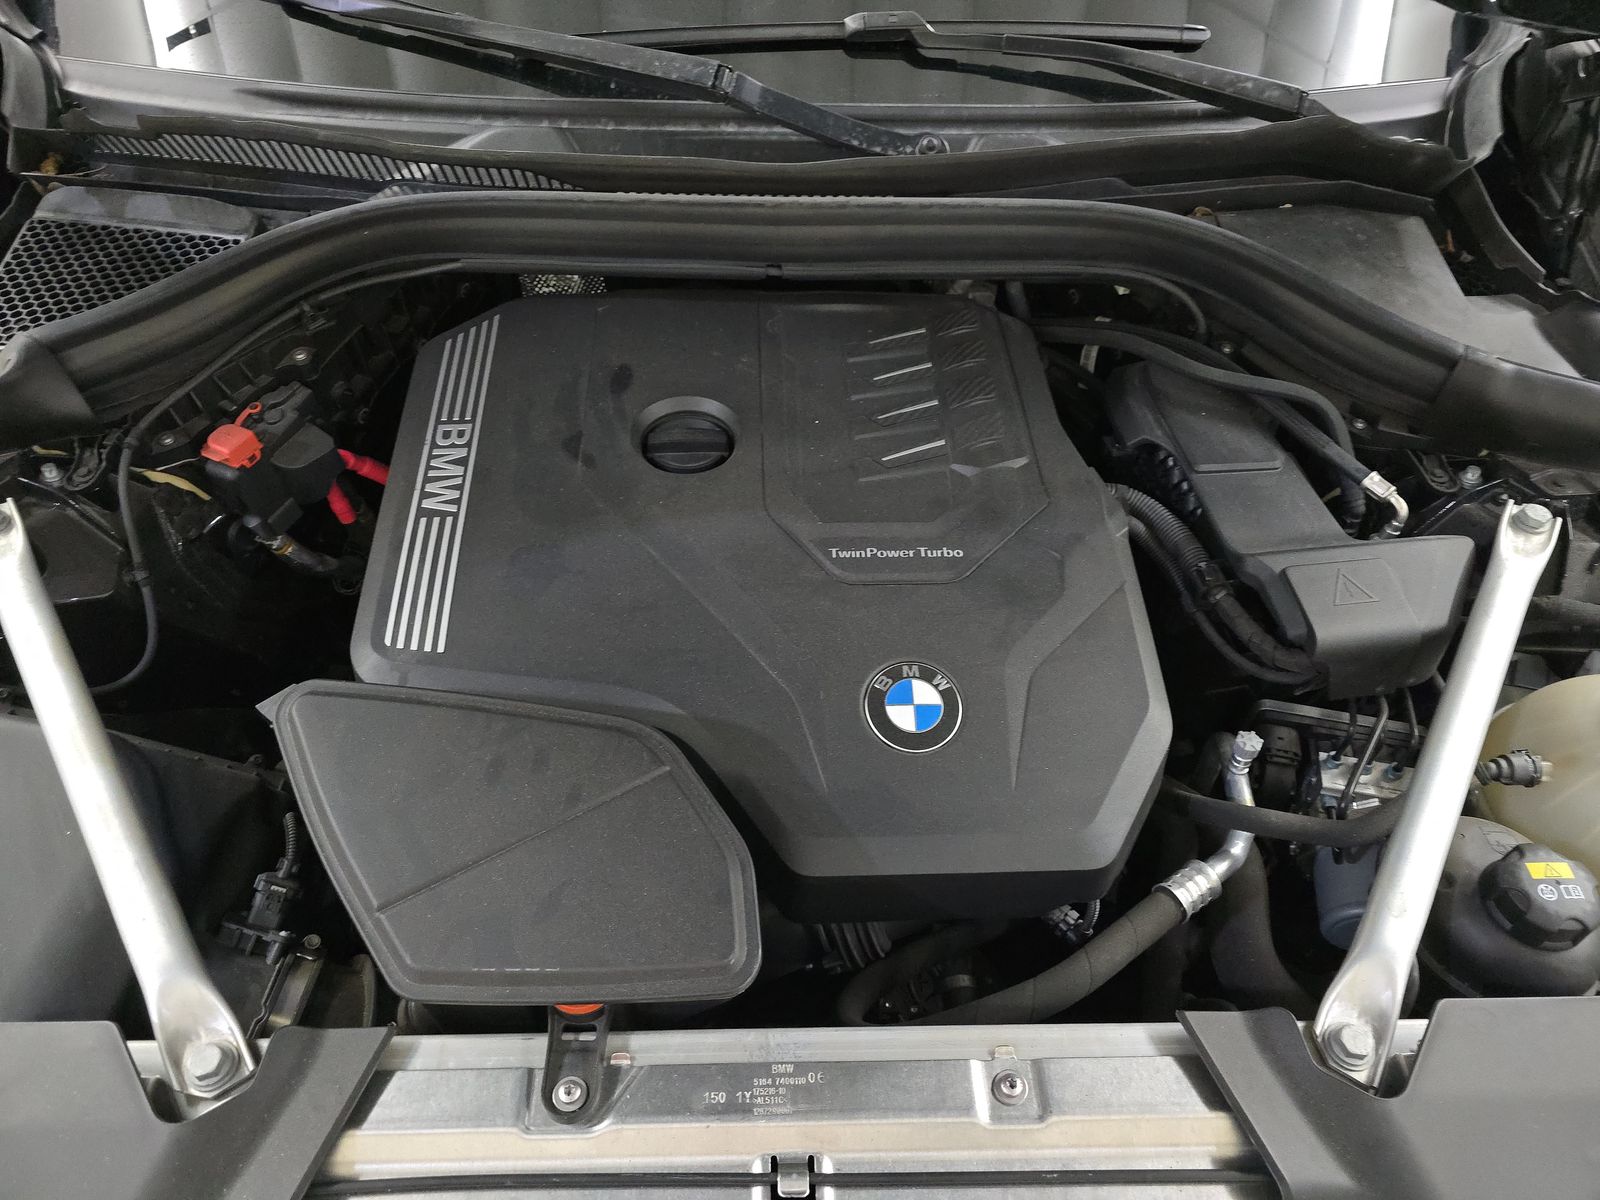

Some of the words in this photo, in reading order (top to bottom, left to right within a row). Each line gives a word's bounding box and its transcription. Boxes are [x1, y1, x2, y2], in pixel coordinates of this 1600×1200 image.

[421, 423, 473, 512] BMW
[828, 547, 915, 558] TwinPower
[917, 547, 964, 557] Turbo
[873, 665, 952, 692] BMW
[771, 1064, 794, 1074] BMW
[703, 1092, 726, 1104] 150
